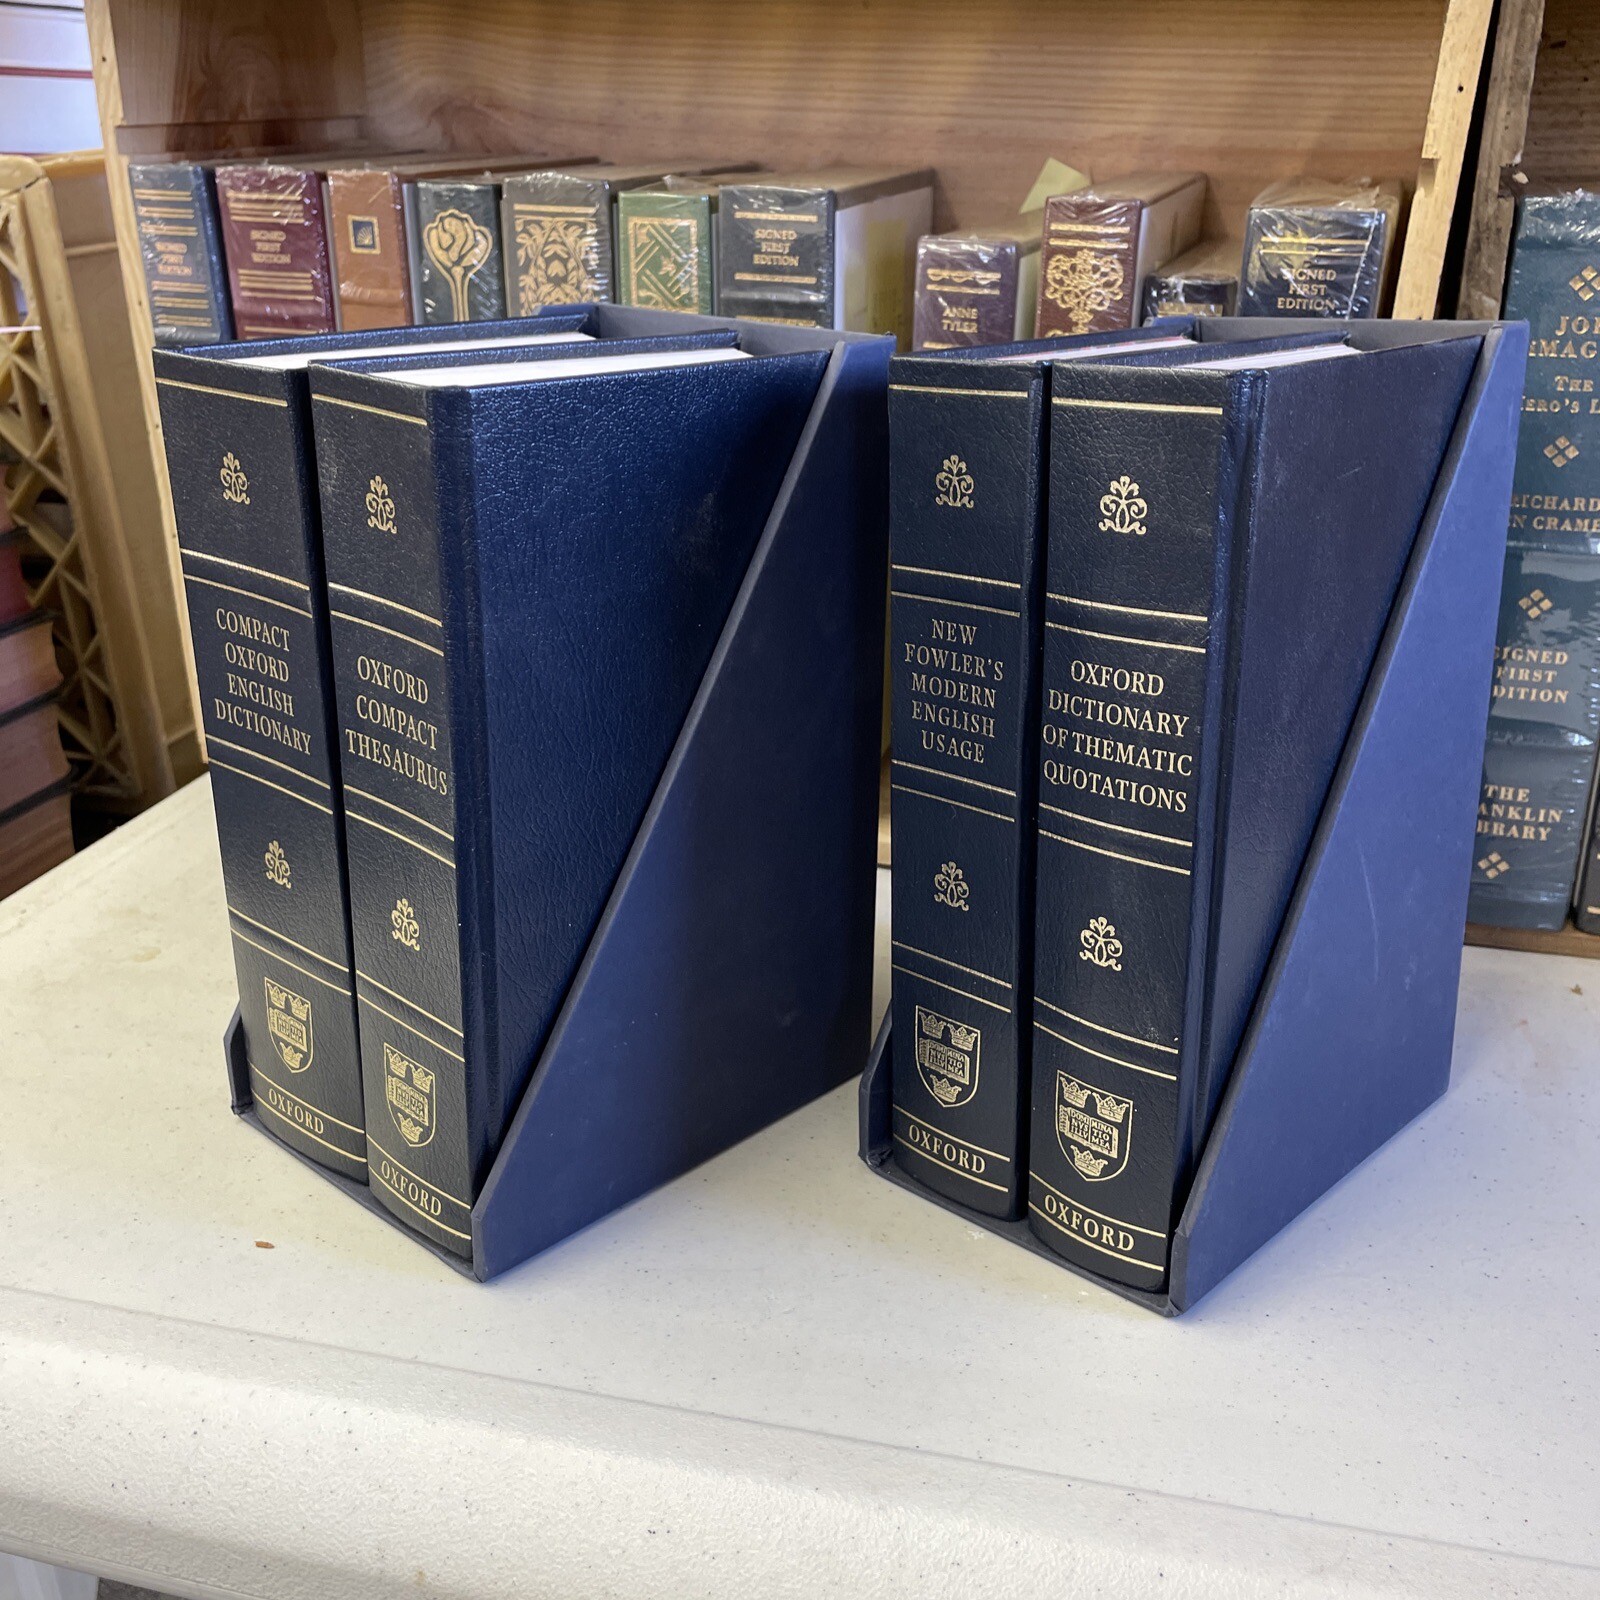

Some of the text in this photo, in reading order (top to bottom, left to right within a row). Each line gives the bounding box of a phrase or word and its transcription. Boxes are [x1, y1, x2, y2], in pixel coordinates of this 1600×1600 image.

[753, 254, 799, 266] EDITION
[1282, 269, 1337, 281] SIGNED
[1277, 298, 1335, 311] EDITION
[1288, 284, 1327, 296] FIRST
[1520, 395, 1579, 414] ERO'S
[216, 608, 290, 651] COMPACT
[931, 618, 977, 645] NEW
[225, 642, 289, 683] OXFORD
[357, 655, 429, 704] OXFORD
[905, 642, 1004, 681] FOWLER'S
[1070, 660, 1164, 696] OXFORD
[1496, 666, 1557, 683] FIRST
[227, 672, 295, 717] ENGLISH
[911, 672, 997, 709] MODERN
[214, 698, 311, 755] DICTIONARY
[356, 694, 438, 750] COMPACT
[911, 700, 995, 738] ENGLISH
[1049, 689, 1189, 738] DICTIONARY
[345, 728, 448, 796] THESAURUS
[922, 729, 985, 764] USAGE
[1042, 724, 1193, 776] OF THEMATIC
[1043, 760, 1187, 813] QUOTATIONS
[1484, 784, 1530, 802] THE
[268, 1088, 324, 1135] OXFORD
[908, 1124, 986, 1174] OXFORD
[381, 1160, 442, 1216] OXFORD
[1044, 1194, 1135, 1251] OXFORD
